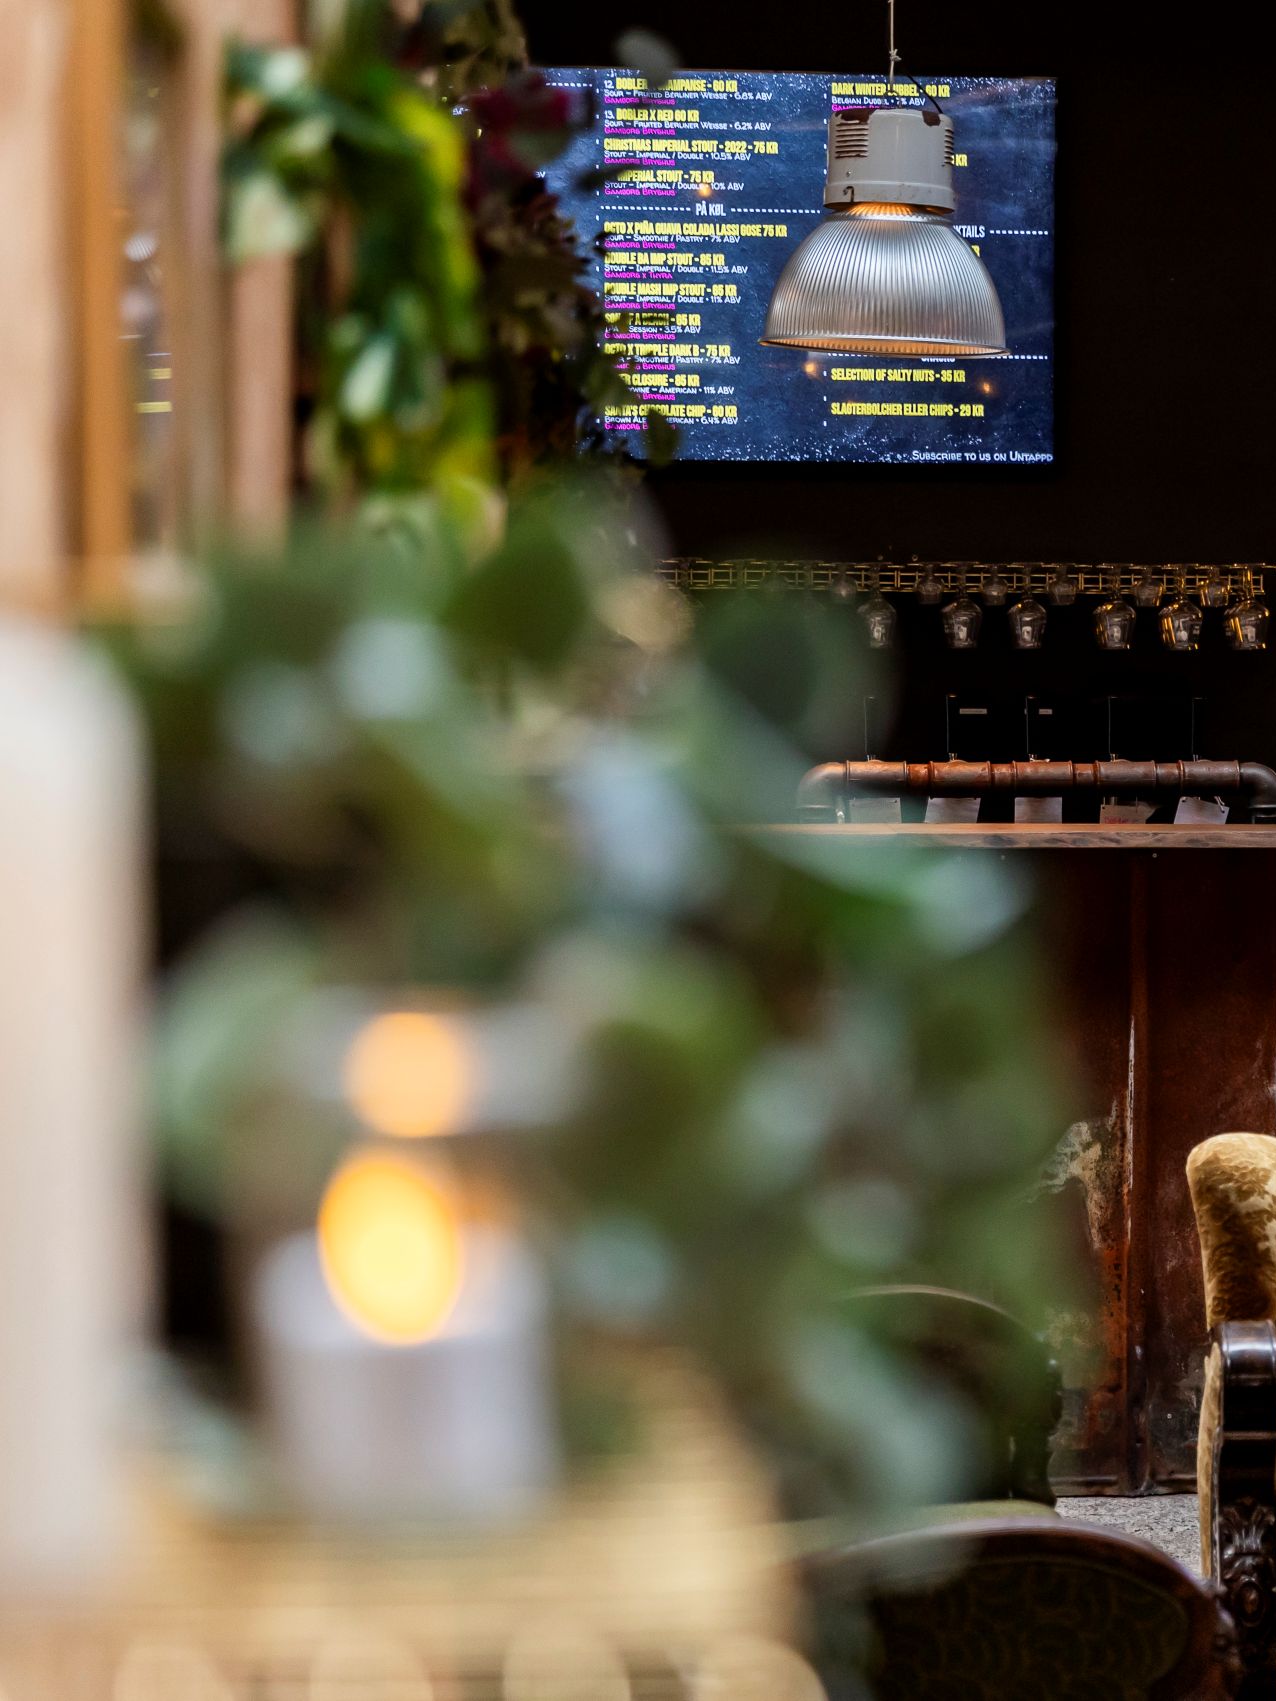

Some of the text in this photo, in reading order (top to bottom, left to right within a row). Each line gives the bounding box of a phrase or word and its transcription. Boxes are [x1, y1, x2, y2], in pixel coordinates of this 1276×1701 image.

[726, 81, 737, 92] KR
[832, 82, 950, 97] DARK WINTER KR
[832, 96, 862, 104] BELGIAN
[616, 108, 699, 122] BOBLER RED 60 KR
[755, 123, 771, 131] ABV
[604, 138, 778, 154] CHRISTMAS IMPERIAL STOUT 2022 75 KR
[735, 153, 750, 161] ABV
[955, 154, 968, 166] KR
[657, 170, 683, 182] STOUT
[702, 171, 714, 183] KR
[696, 201, 726, 216] PÅ KØL
[604, 220, 787, 238] OCTO PIÑA GUAVA COLADA LASSI GOSE 75 KR
[633, 234, 668, 242] SMOOTHIE
[676, 235, 703, 243] PASTRY
[604, 252, 724, 266] DOUBLE BA IMP STOUT KR
[731, 266, 748, 274] ABV
[604, 282, 737, 297] DOUBLE MASH IMP STOUT KR
[689, 314, 701, 327] KR
[669, 345, 692, 357] DARK
[706, 346, 718, 357] 75
[720, 346, 731, 357] KR
[632, 374, 668, 386] CLOSURE
[688, 375, 699, 387] KR
[831, 368, 965, 382] SELECTION OF SALTY NUTS 35 KR
[718, 387, 734, 395] ABV
[687, 406, 737, 418] CHIP KR
[831, 402, 984, 417] SLAGTERBOLCHER ELLER CHIPS 29 KR
[912, 450, 1053, 462] SUBSCRIBE TO US ON UNTAPPD
